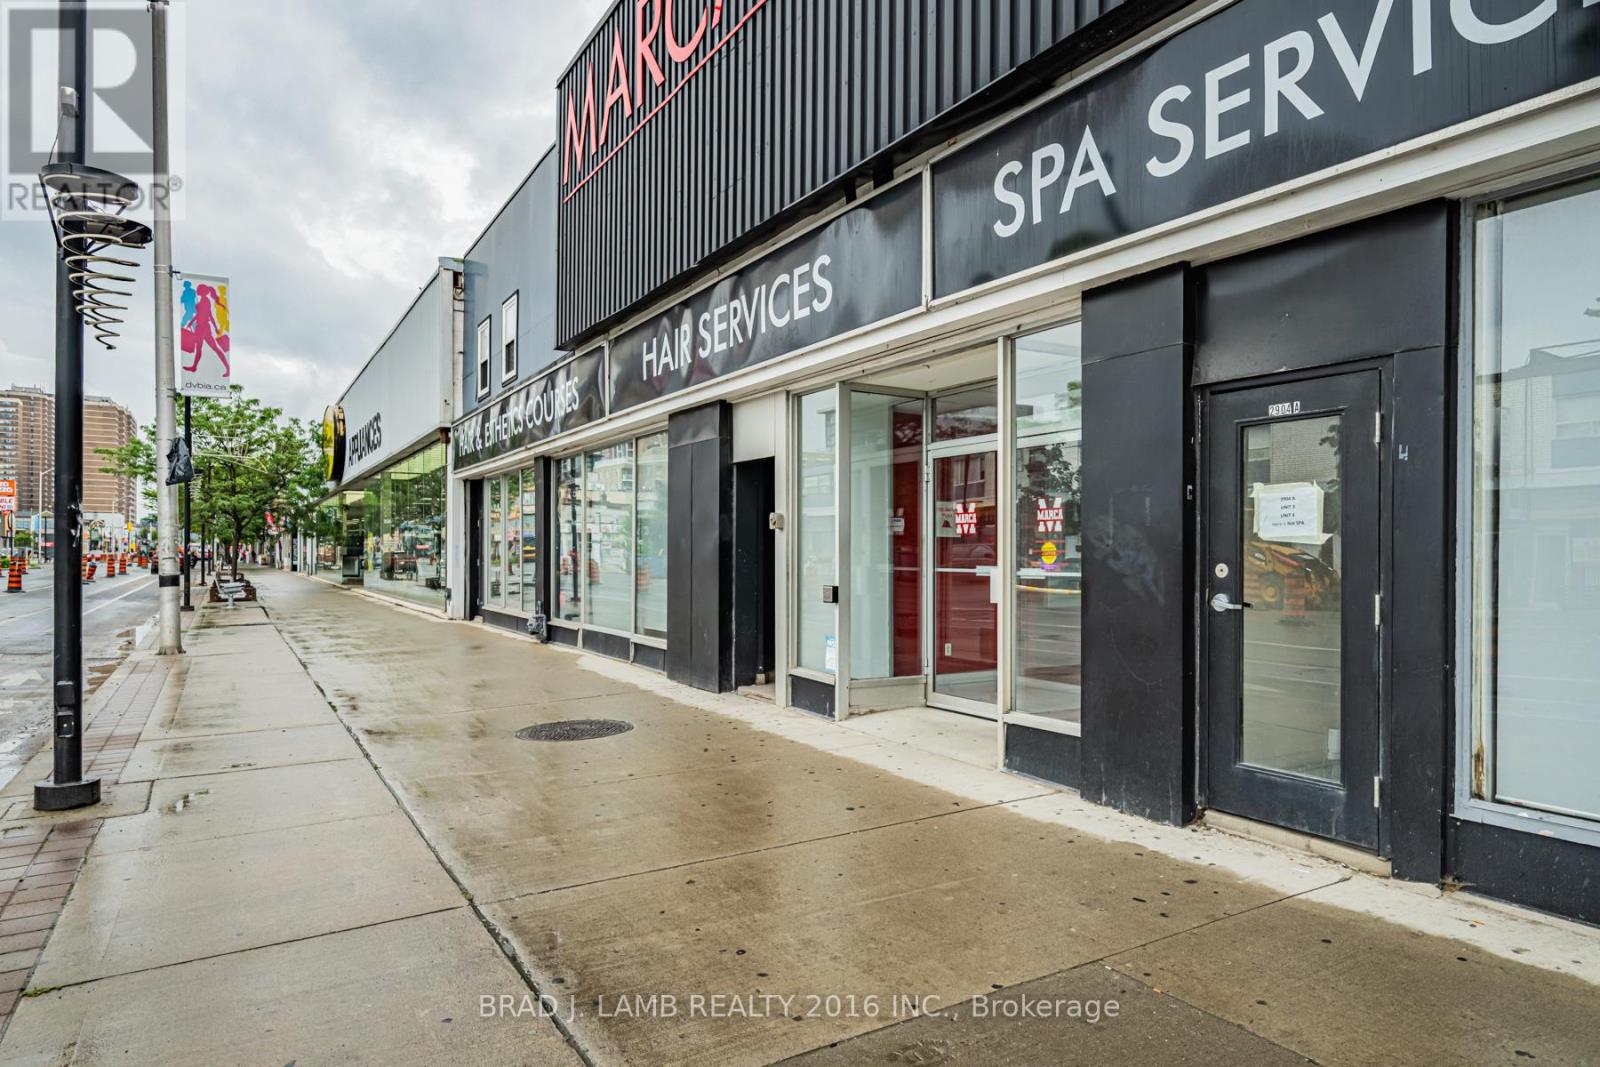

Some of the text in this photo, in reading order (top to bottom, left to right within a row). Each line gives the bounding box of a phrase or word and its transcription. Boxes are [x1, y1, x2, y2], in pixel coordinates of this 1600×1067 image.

[563, 0, 724, 186] MARC
[993, 125, 1117, 238] SPA
[642, 254, 833, 381] HAIR SERVICES
[185, 381, 227, 390] dvbia.ca
[459, 426, 475, 456] HAIR
[475, 428, 483, 450] &
[526, 376, 579, 429] COURSES
[348, 411, 382, 467] APPLIANCES
[955, 513, 977, 523] MARCA
[1037, 509, 1063, 520] MARCA
